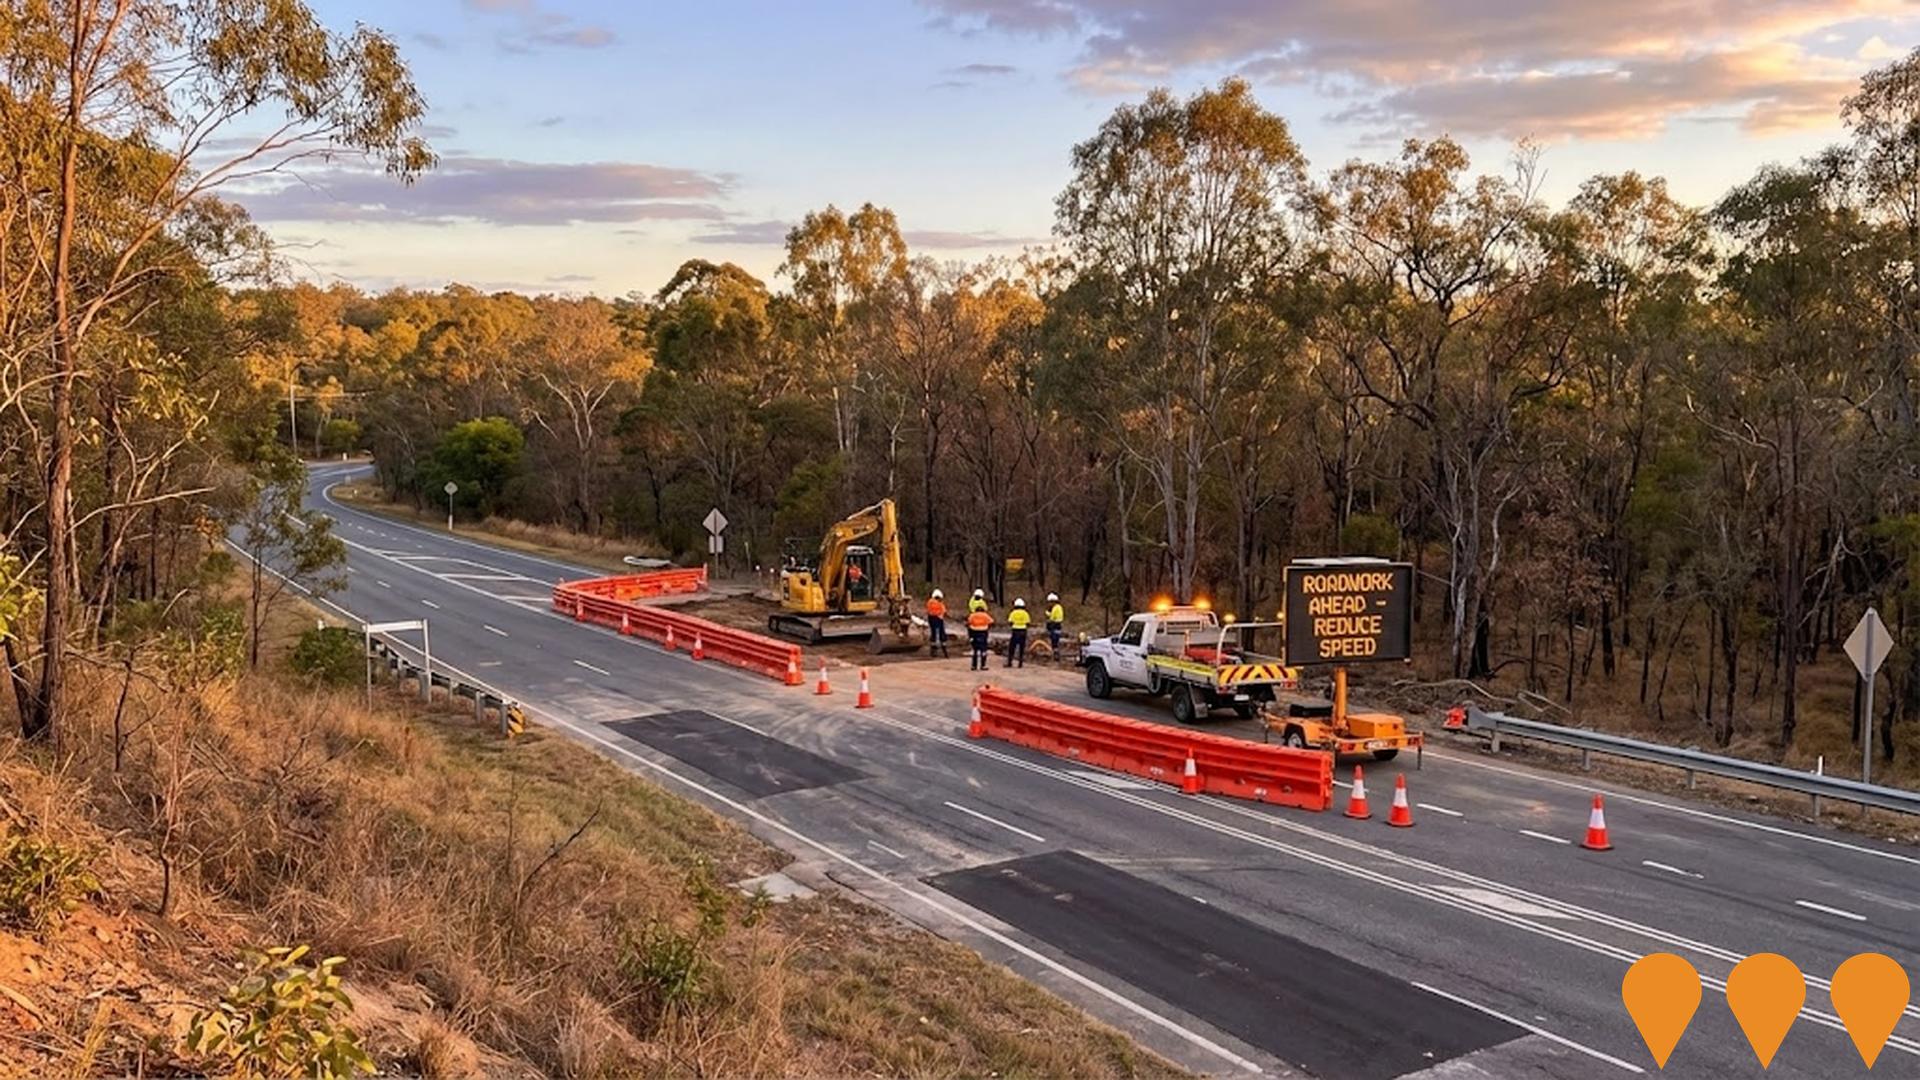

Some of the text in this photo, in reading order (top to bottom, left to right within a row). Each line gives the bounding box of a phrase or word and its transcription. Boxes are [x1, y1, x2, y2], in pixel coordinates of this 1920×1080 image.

[1303, 573, 1393, 593] ROADWORK
[1309, 595, 1366, 615] AHEAD
[1314, 615, 1382, 636] REDUCE
[1320, 637, 1376, 657] SPEED
